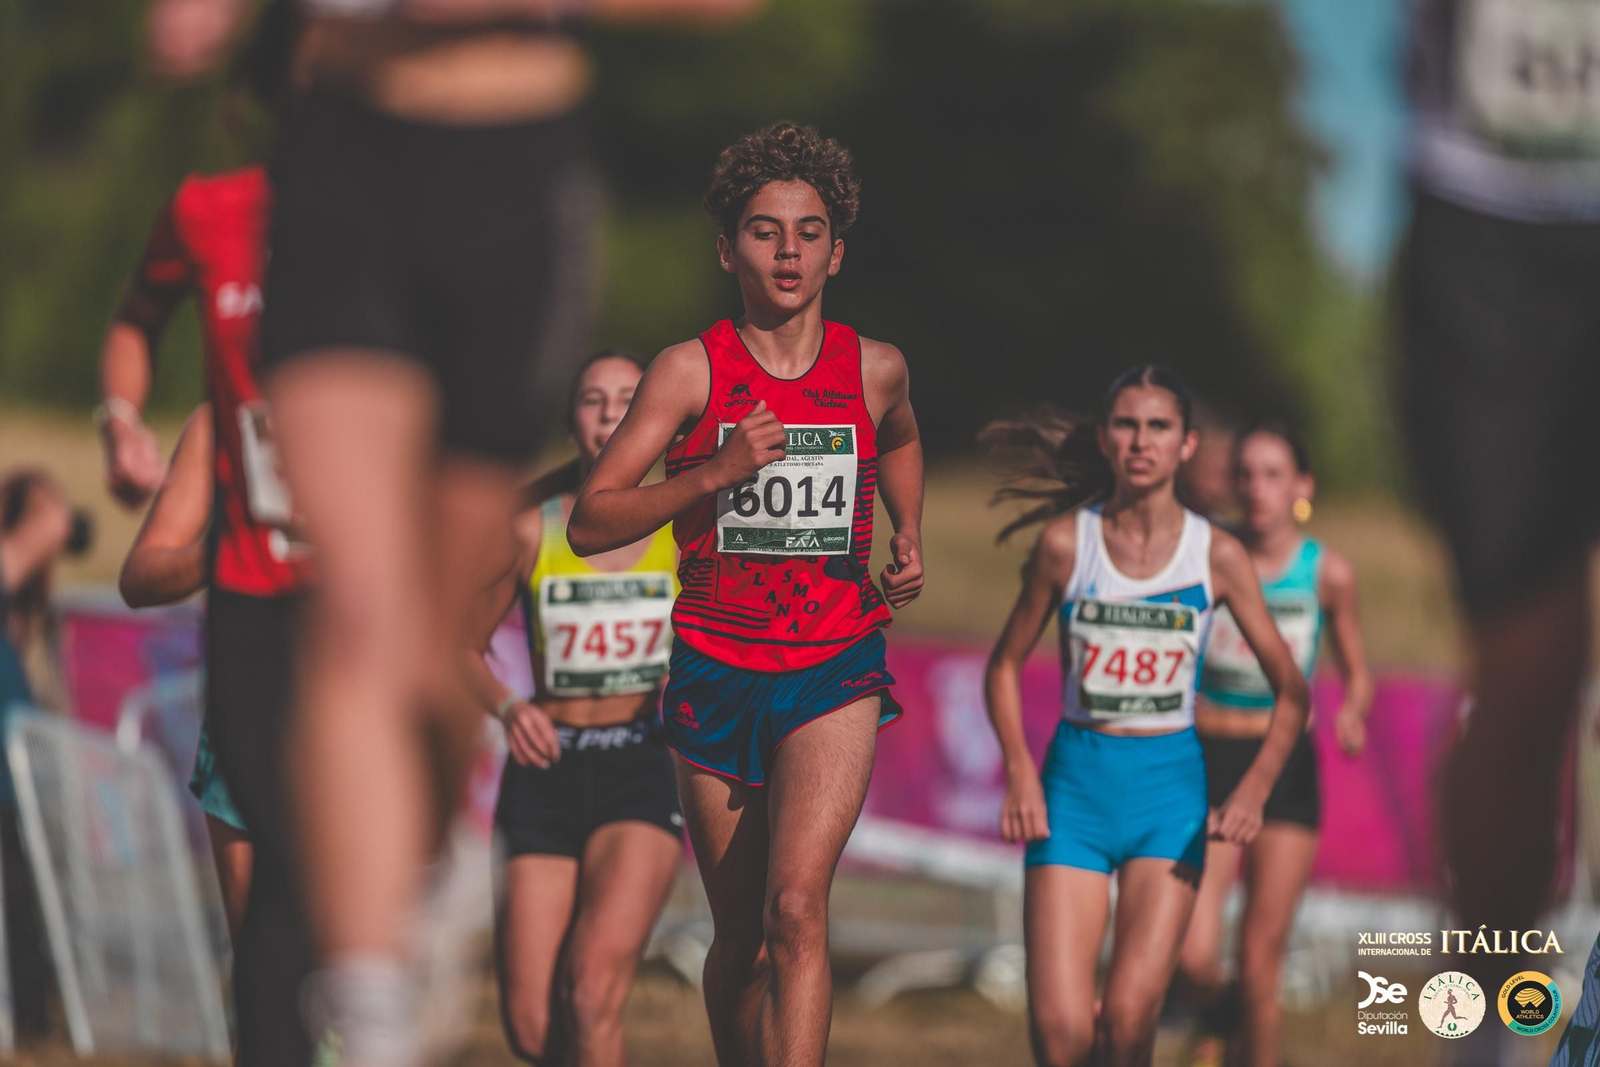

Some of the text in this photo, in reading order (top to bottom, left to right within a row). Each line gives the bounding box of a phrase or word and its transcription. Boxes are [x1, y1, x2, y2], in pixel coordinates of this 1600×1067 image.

[732, 475, 846, 518] 6014
[555, 618, 664, 661] 7457
[1082, 643, 1185, 685] 7487
